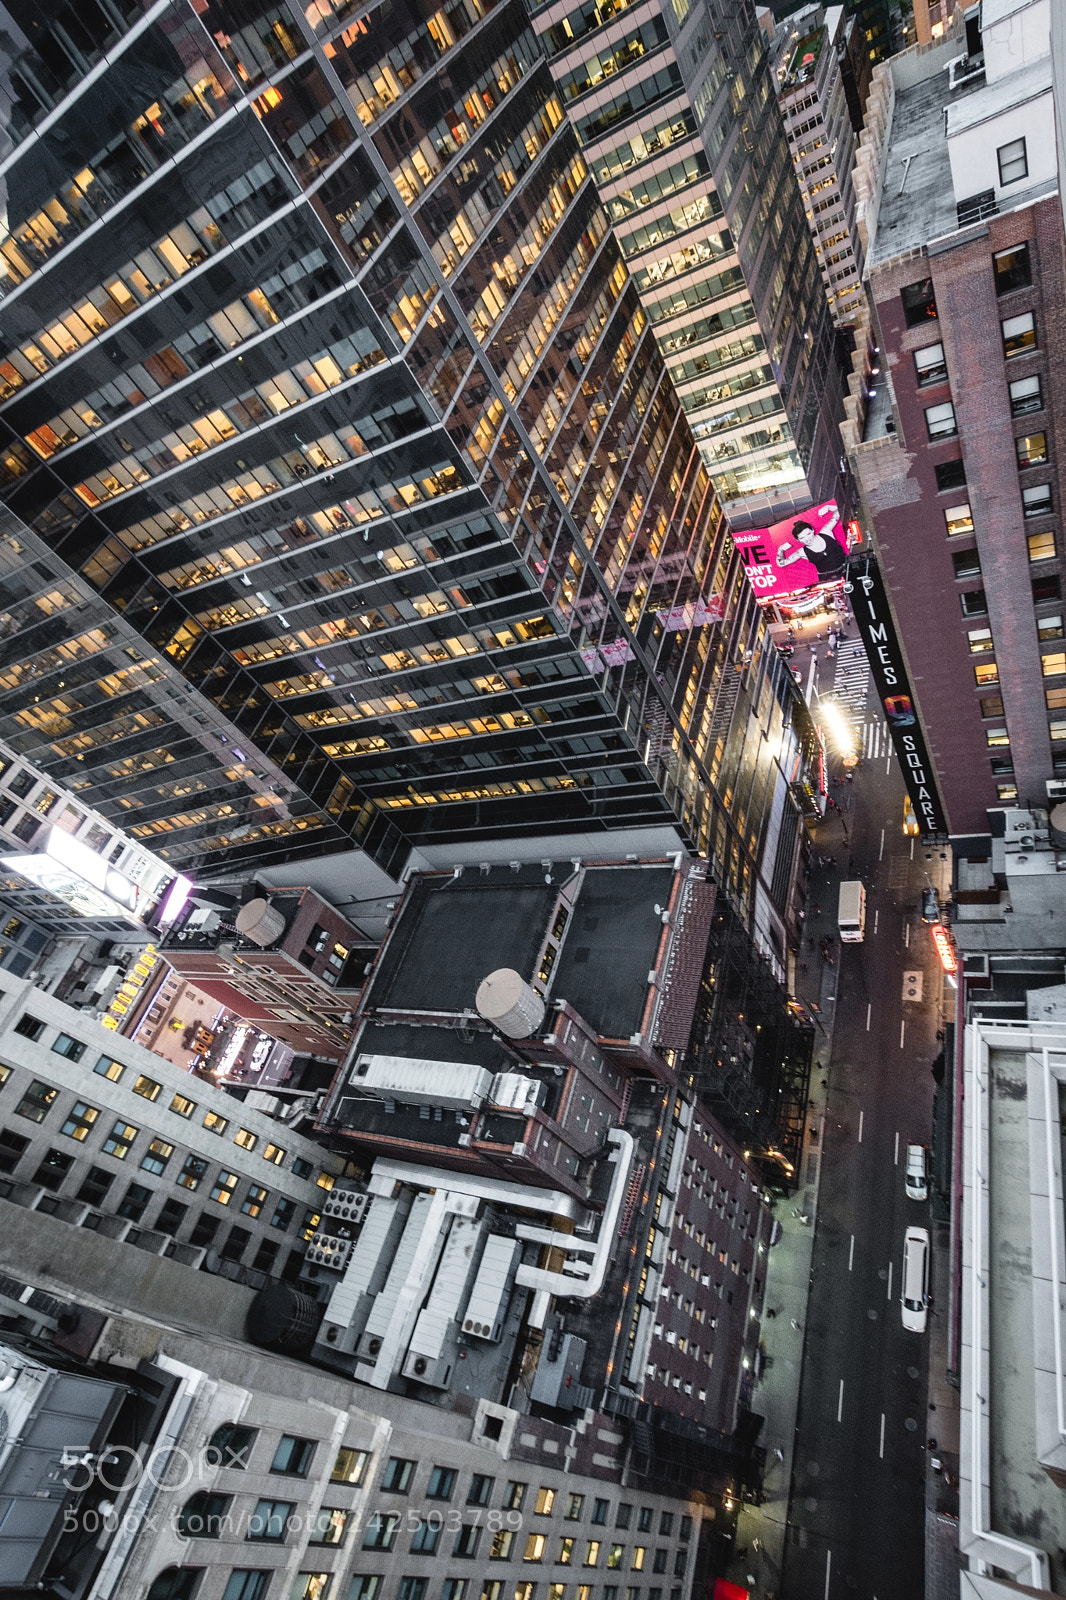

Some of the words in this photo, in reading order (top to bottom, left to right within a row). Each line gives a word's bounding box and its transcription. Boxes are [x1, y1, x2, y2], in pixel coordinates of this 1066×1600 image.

[745, 564, 772, 576] ON'T
[749, 575, 777, 589] TOP
[902, 735, 938, 830] SQUARE
[110, 943, 160, 1015] VICTORY
